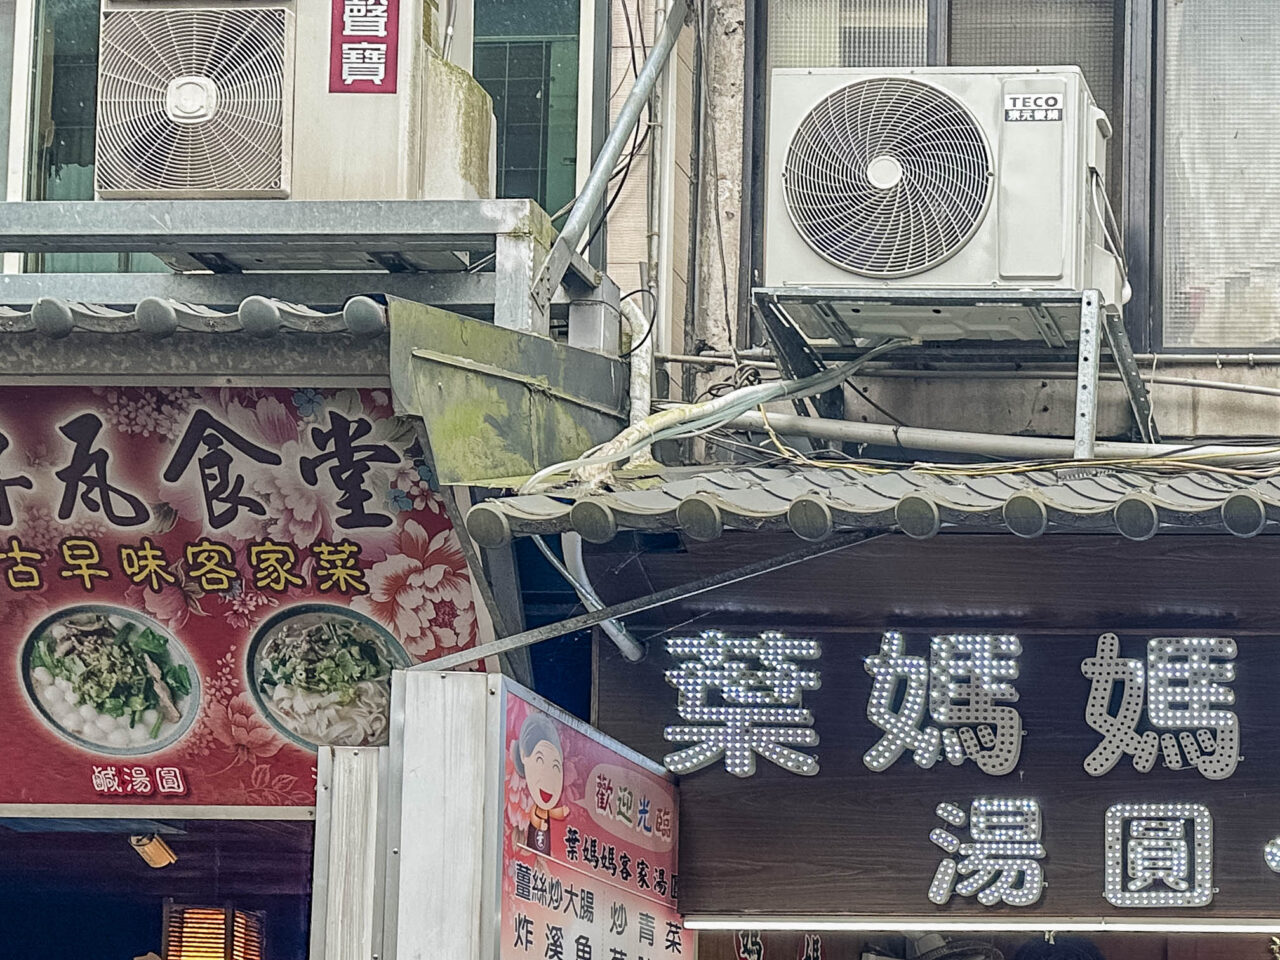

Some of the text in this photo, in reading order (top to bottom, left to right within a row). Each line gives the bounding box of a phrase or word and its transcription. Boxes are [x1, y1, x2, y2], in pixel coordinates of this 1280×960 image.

[342, 0, 388, 85] 聲寶
[1009, 96, 1058, 107] TECO
[0, 540, 368, 593] 古早味客家菜
[91, 765, 187, 794] 鹹湯圓
[595, 773, 672, 842] 歡迎光臨
[514, 862, 596, 924] 薑絲炒大腸
[609, 901, 682, 954] 炒青菜
